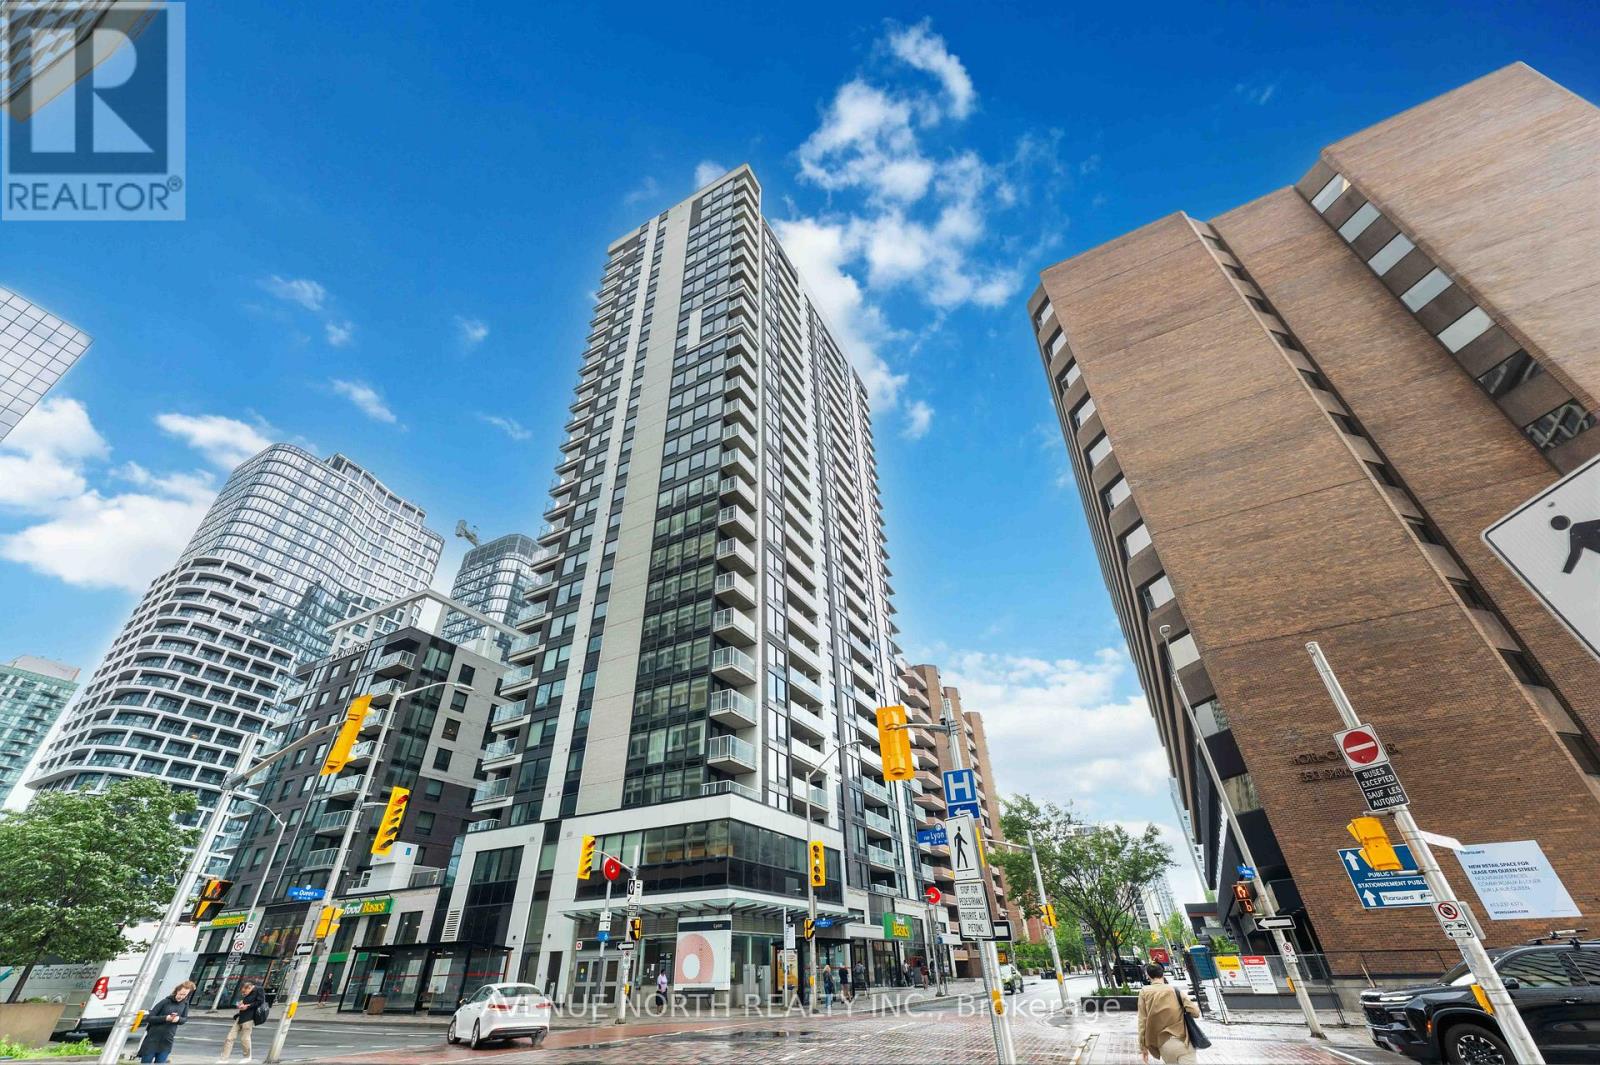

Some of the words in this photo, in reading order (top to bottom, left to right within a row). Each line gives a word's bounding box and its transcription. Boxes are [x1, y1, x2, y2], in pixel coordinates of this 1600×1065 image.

[1362, 767, 1386, 779] BUSES
[947, 772, 973, 800] H
[1361, 775, 1394, 788] EXCEPTED
[1366, 790, 1384, 800] SAUF
[1387, 785, 1401, 795] LES
[1373, 794, 1404, 807] AUTOBUS
[930, 831, 945, 842] Lyon
[960, 885, 969, 894] STOP
[970, 885, 978, 894] FOR
[1357, 880, 1406, 889] STATIONNEMENT
[959, 896, 984, 906] PEDESTRIANS
[344, 903, 364, 916] food
